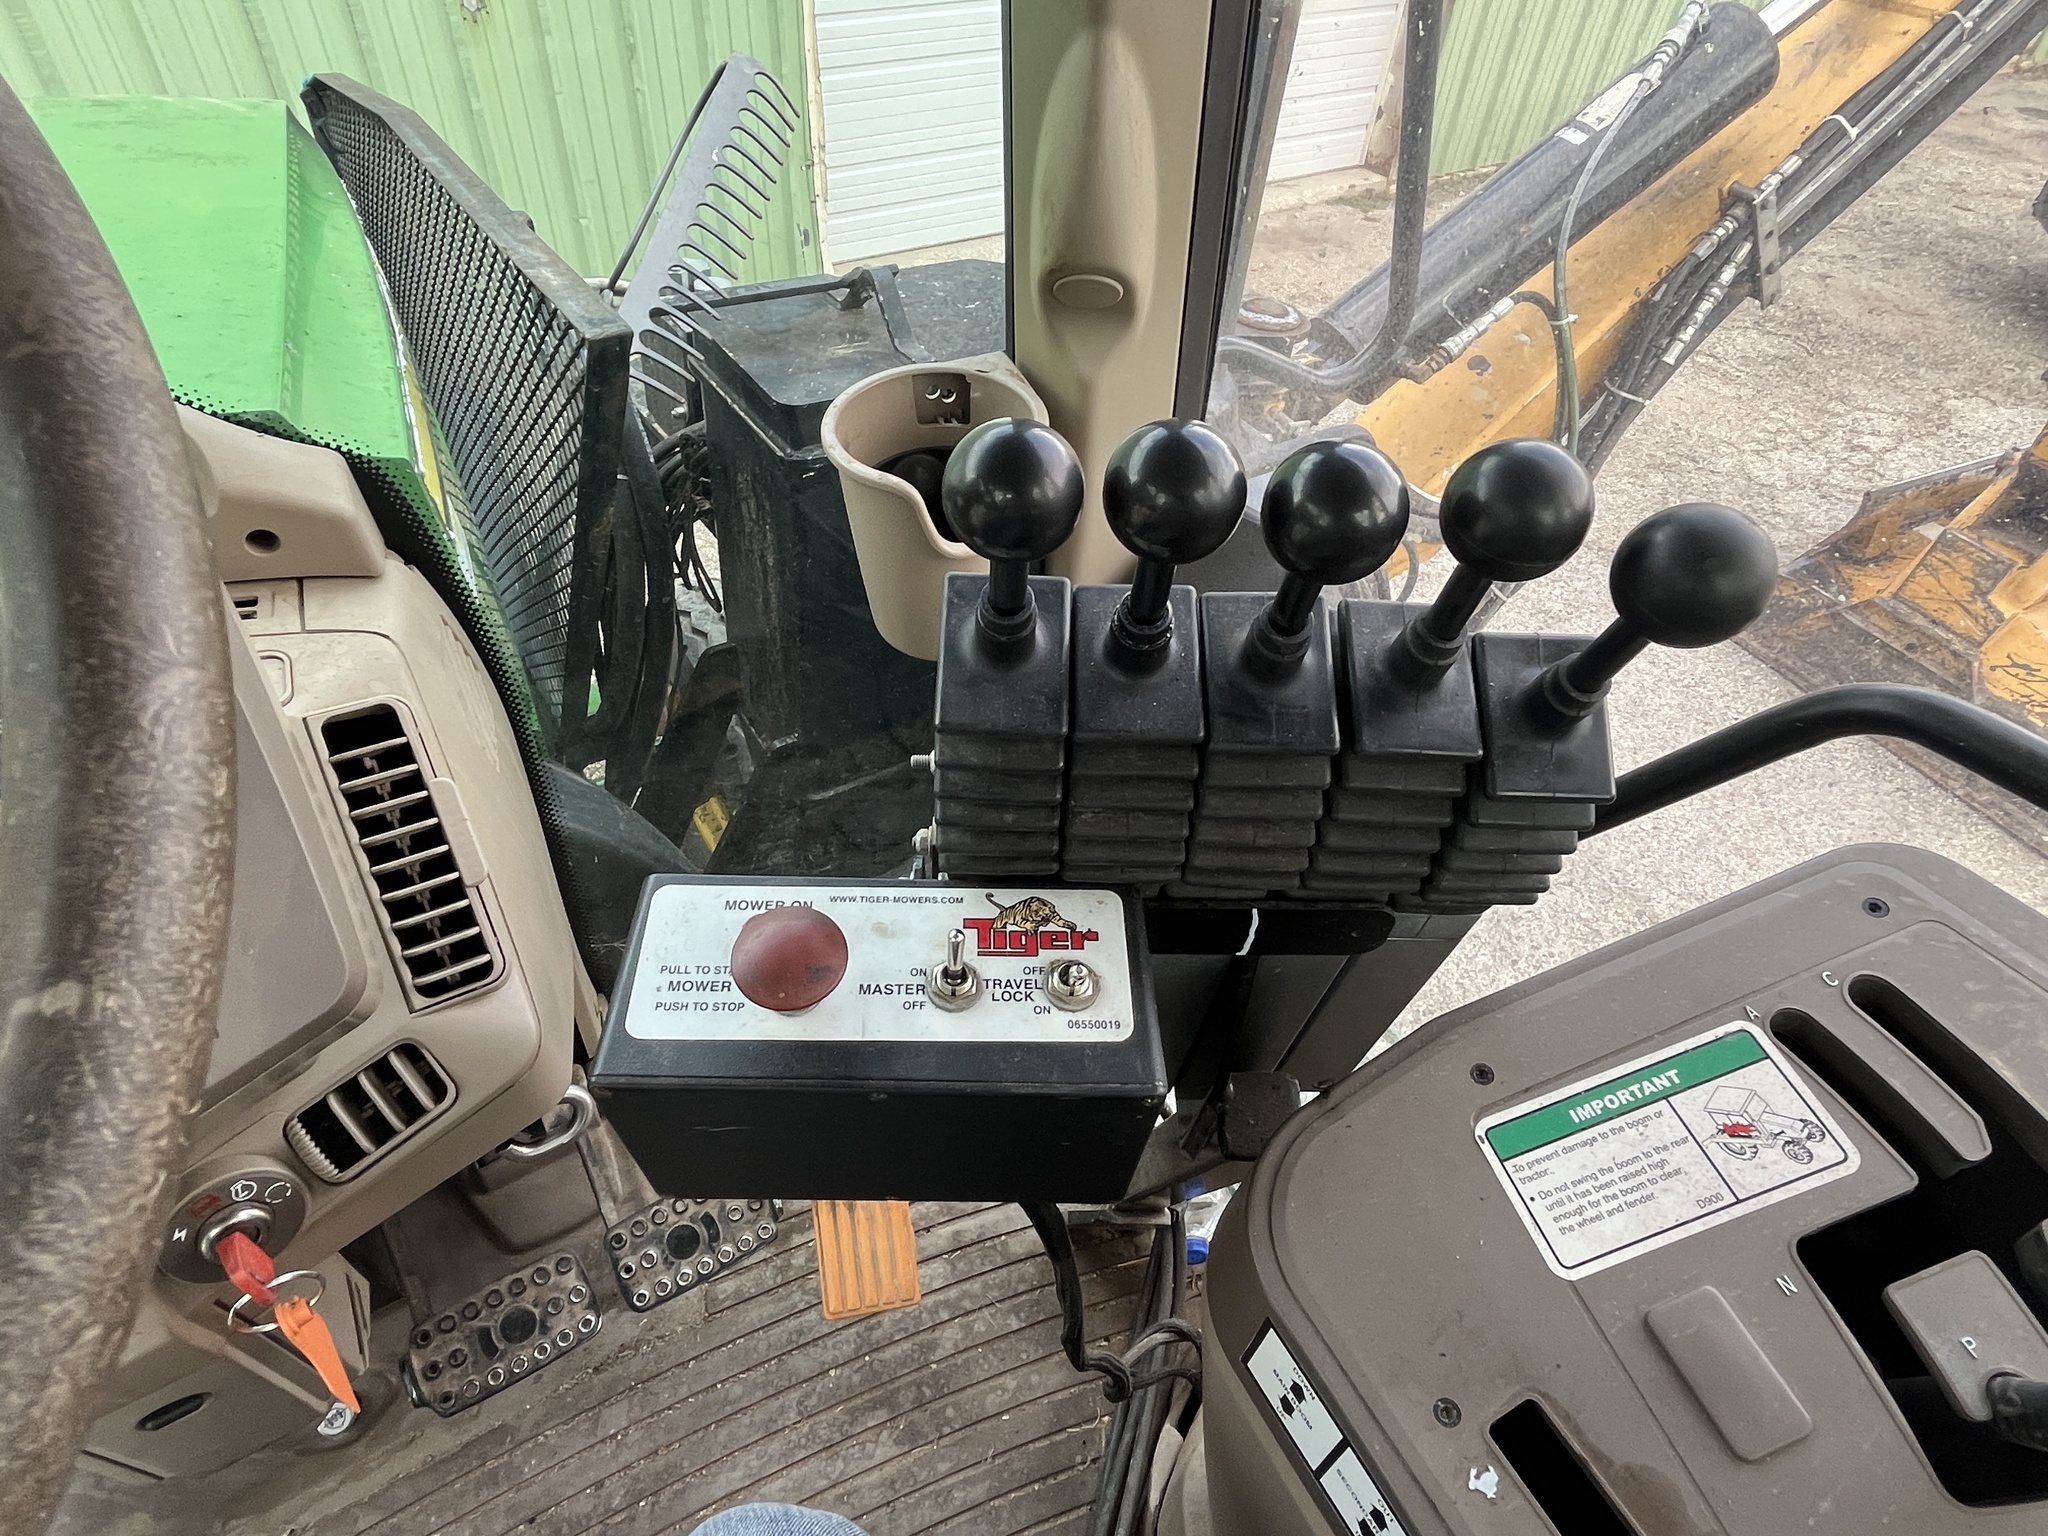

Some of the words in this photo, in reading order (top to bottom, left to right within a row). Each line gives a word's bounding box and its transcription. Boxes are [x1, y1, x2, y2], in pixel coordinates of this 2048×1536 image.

[724, 900, 785, 911] MOWER
[829, 895, 964, 905] WWW.TIGER-MOWERS.COM
[963, 917, 1099, 957] Tiger
[660, 965, 691, 975] PULL
[695, 965, 711, 975] TO
[714, 965, 732, 976] ST
[910, 968, 928, 978] ON
[1022, 966, 1046, 976] OFF
[1821, 970, 1840, 987] C
[667, 980, 732, 992] MOWER
[858, 983, 926, 996] MASTER
[983, 978, 1043, 990] TRAVEL
[991, 990, 1035, 1002] LOCK
[655, 1002, 689, 1012] PUSH
[693, 1002, 709, 1012] TO
[712, 1002, 745, 1012] STOP
[903, 1001, 927, 1011] OFF
[1033, 1005, 1051, 1015] ON
[1744, 1005, 1761, 1021] A
[1067, 1020, 1121, 1030] 06550019
[1567, 1068, 1682, 1125] IMPORTANT
[1512, 1163, 1526, 1174] To
[1525, 1149, 1562, 1172] prevent
[1561, 1136, 1598, 1156] damage
[1599, 1130, 1610, 1140] to
[1609, 1123, 1626, 1136] the
[1625, 1115, 1653, 1130] boom
[1653, 1109, 1665, 1119] or
[1537, 1190, 1554, 1202] Do
[1554, 1180, 1571, 1193] not
[1571, 1170, 1600, 1190] swing
[1597, 1163, 1615, 1177] the
[1614, 1152, 1644, 1171] boom
[1642, 1148, 1654, 1160] to
[1653, 1142, 1671, 1157] the
[1670, 1134, 1691, 1148] rear
[1545, 1197, 1566, 1212] until
[1566, 1193, 1574, 1203] it
[1573, 1187, 1593, 1200] has
[1593, 1177, 1620, 1194] been
[1618, 1164, 1650, 1184] raised
[1648, 1156, 1671, 1175] high
[1552, 1203, 1589, 1224] enough
[1587, 1197, 1604, 1210] for
[1601, 1192, 1620, 1206] the
[1619, 1180, 1648, 1198] boom
[1645, 1176, 1659, 1187] to
[1696, 1192, 1725, 1210] D900
[1557, 1223, 1576, 1237] the
[1574, 1212, 1606, 1229] wheel
[1605, 1202, 1625, 1218] and
[1622, 1190, 1659, 1211] fender.
[1776, 1275, 1798, 1297] N
[1961, 1337, 1979, 1359] P
[1292, 1367, 1316, 1400] DOWN
[1272, 1368, 1290, 1395] MAIN
[1290, 1397, 1313, 1431] BOOM
[1336, 1468, 1381, 1536] SECONDAR
